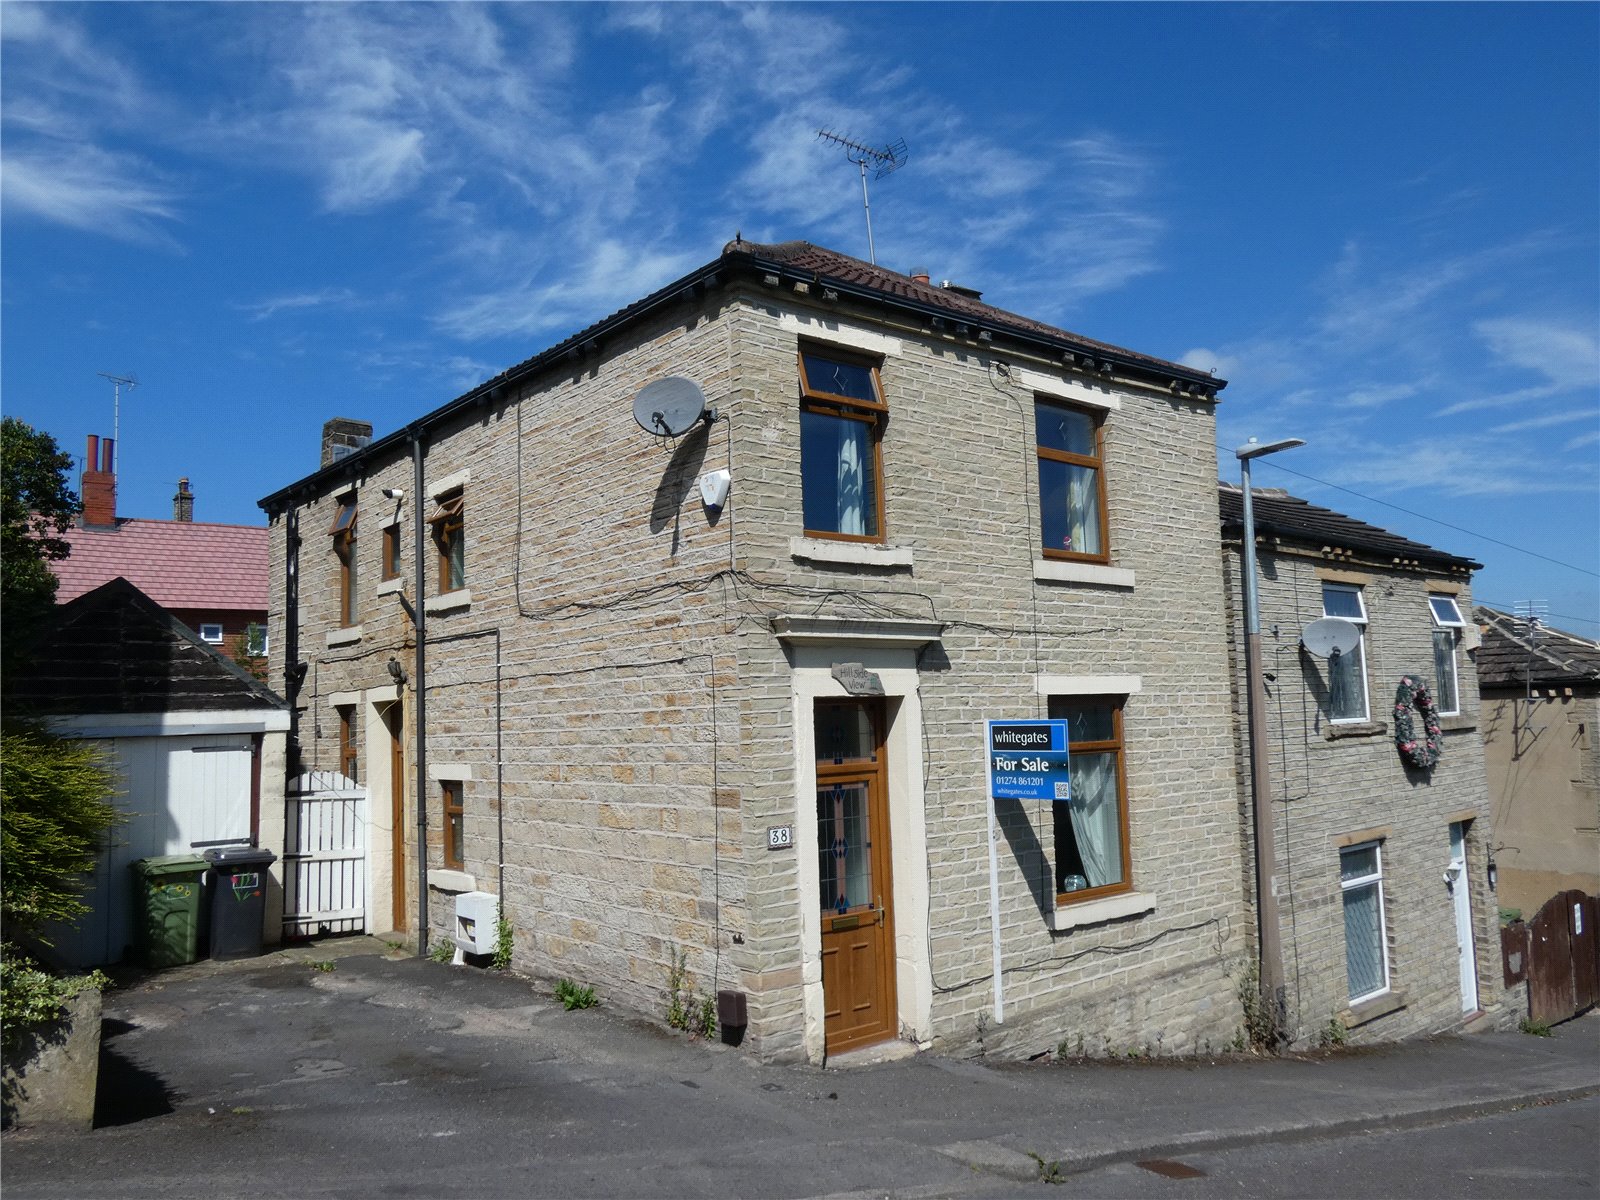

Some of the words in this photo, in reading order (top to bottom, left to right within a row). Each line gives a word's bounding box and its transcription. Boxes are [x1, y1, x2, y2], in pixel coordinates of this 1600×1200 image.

[840, 666, 869, 679] Hillside
[848, 679, 866, 690] View
[995, 731, 1048, 746] whitegates
[995, 757, 1017, 771] For
[1021, 757, 1049, 772] Sale
[996, 776, 1017, 785] 01274
[1018, 777, 1044, 786] 861201
[997, 788, 1038, 796] whitegates.co.uk
[772, 829, 788, 843] 38
